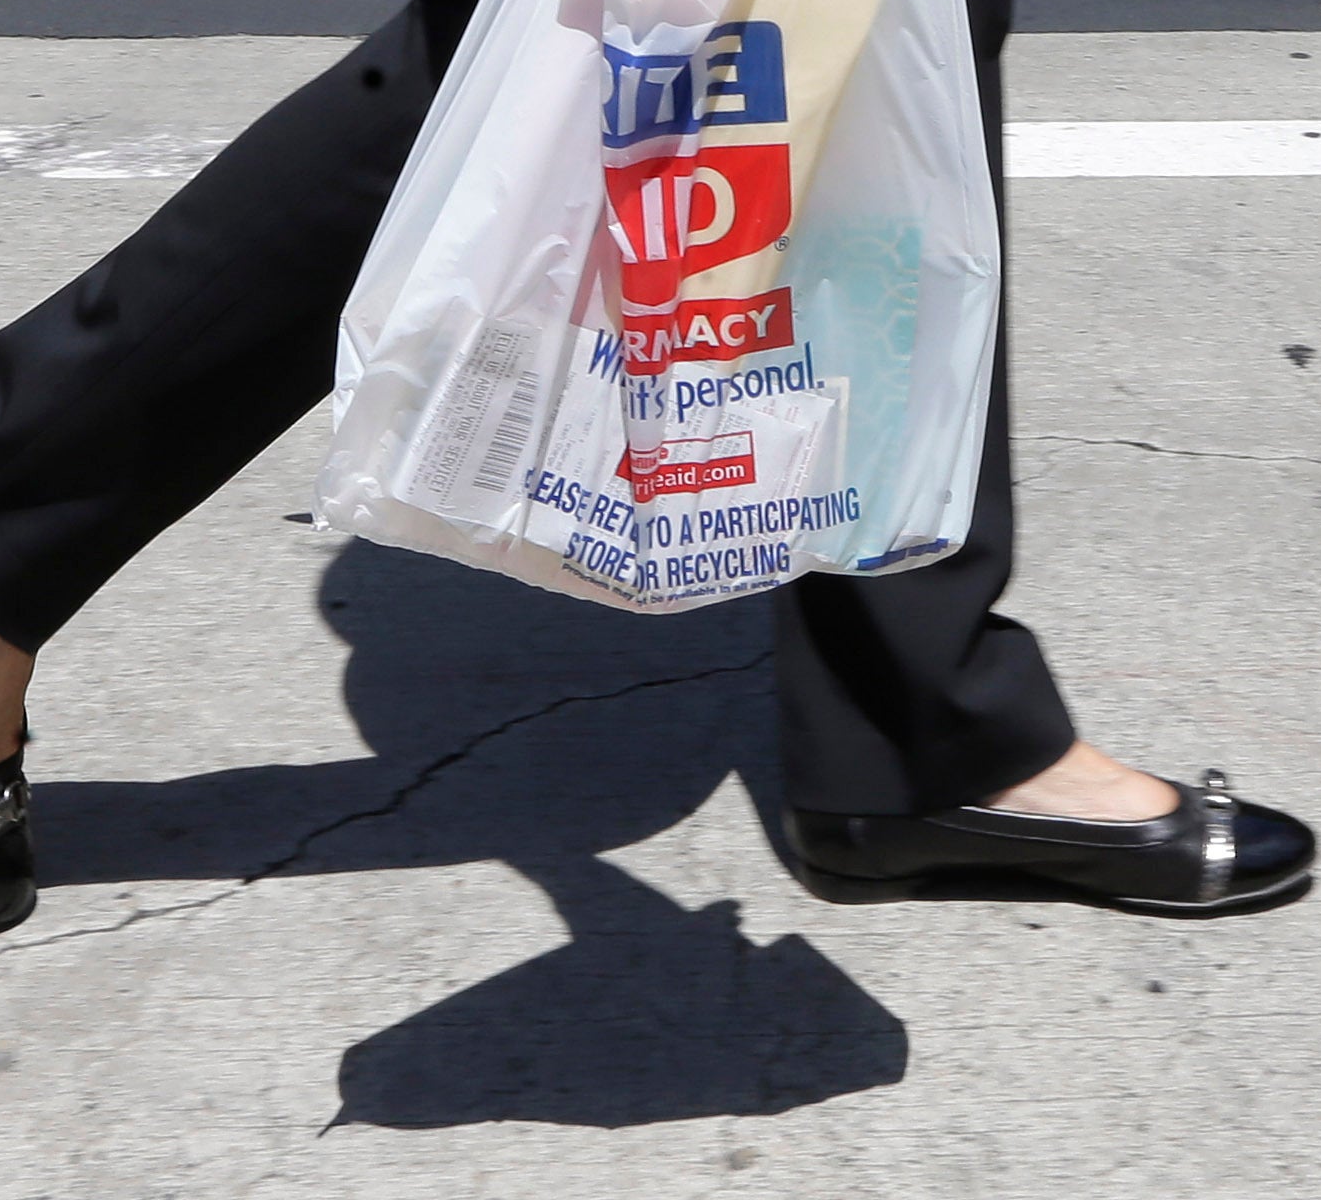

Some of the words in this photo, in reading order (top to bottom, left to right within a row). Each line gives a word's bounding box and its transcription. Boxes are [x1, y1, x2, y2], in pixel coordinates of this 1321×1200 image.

[467, 377, 491, 410] ABOUT
[630, 375, 665, 420] it's
[676, 341, 825, 423] personal.
[453, 415, 476, 441] YOUR
[429, 445, 460, 493] SERVICE!
[635, 463, 745, 496] riteaid.com
[679, 514, 694, 546] A
[699, 487, 861, 543] PARTICIPATING
[563, 532, 637, 583] STORE
[667, 542, 791, 588] RECYCLING
